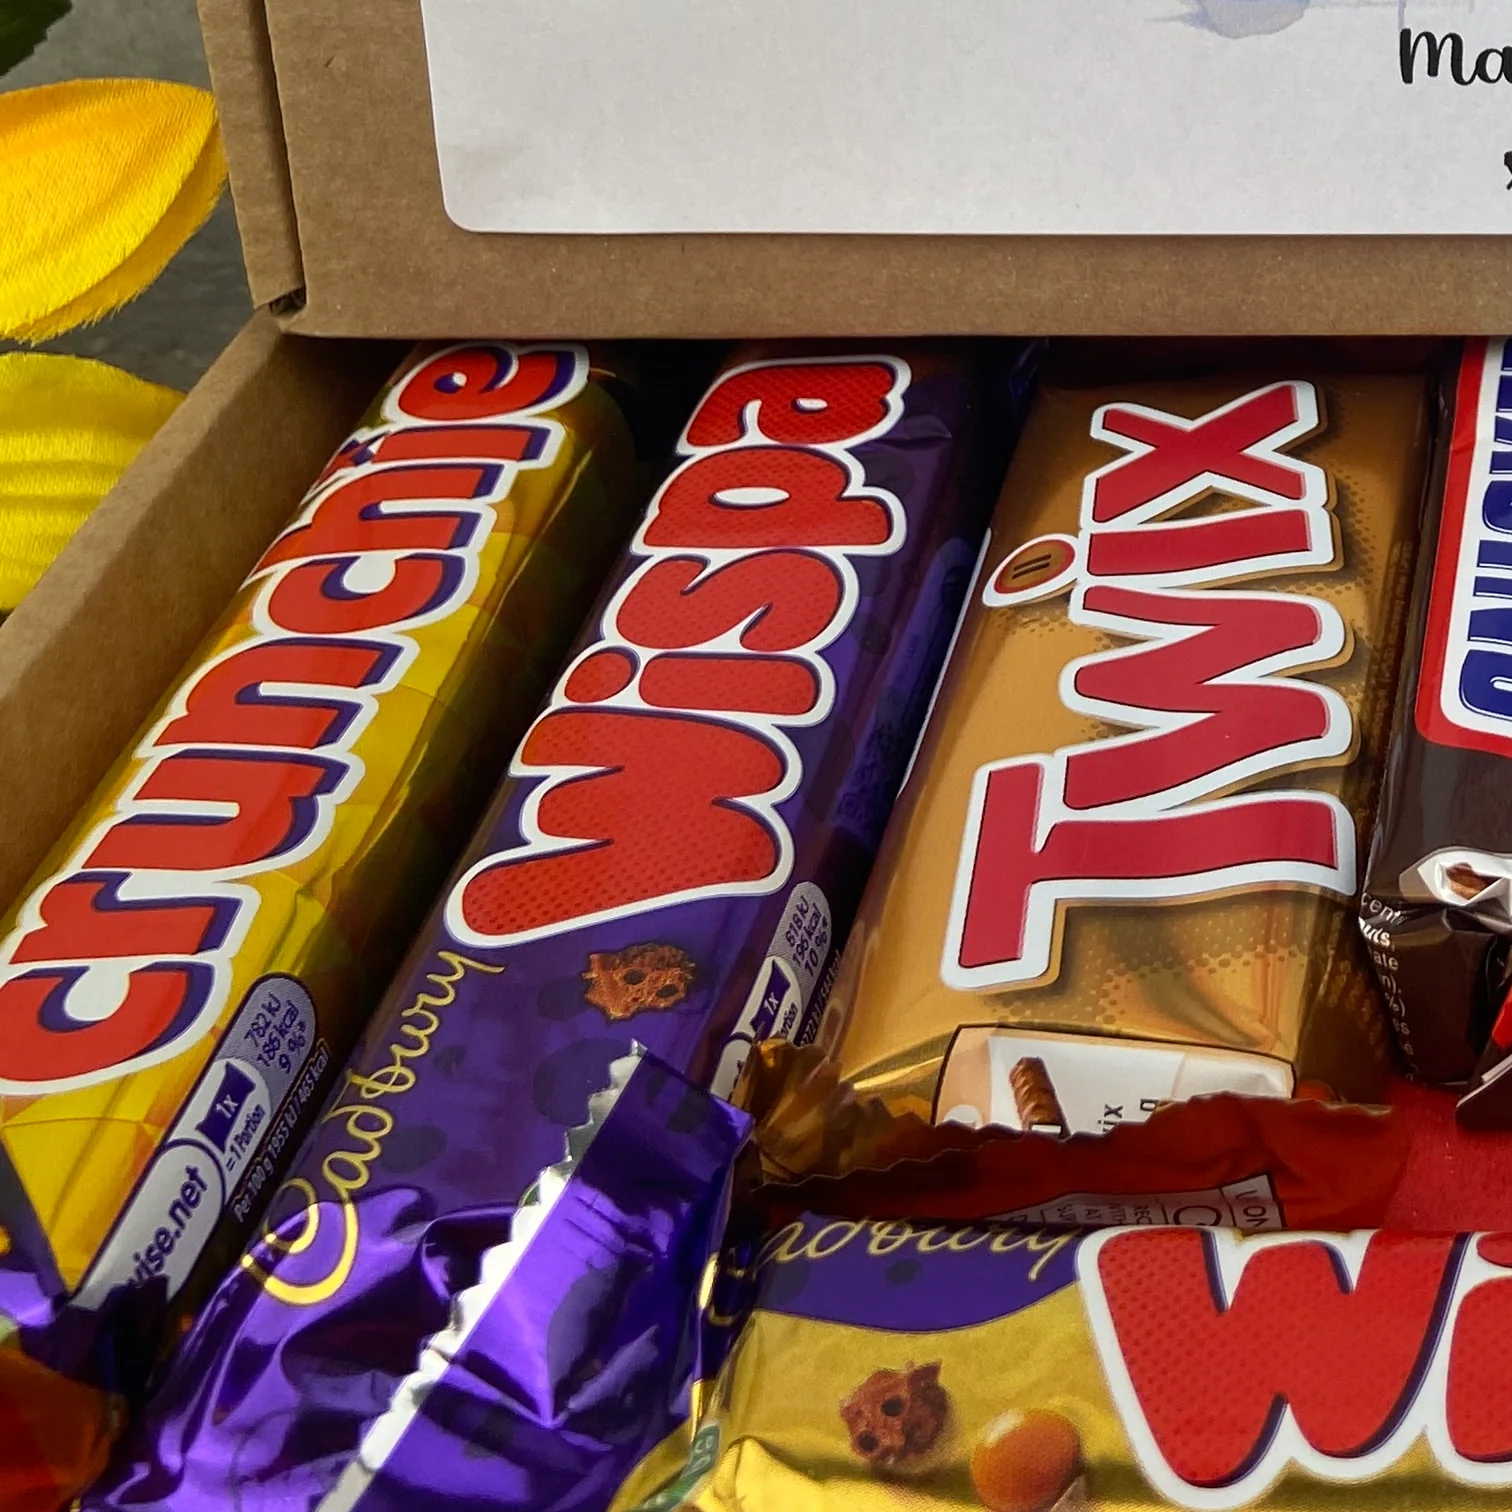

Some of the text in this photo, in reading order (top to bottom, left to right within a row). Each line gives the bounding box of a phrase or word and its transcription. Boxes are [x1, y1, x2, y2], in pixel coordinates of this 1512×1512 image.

[763, 991, 780, 1016] 1x
[244, 1013, 270, 1047] 782
[275, 1000, 300, 1039] kcal
[279, 1054, 292, 1074] 9
[215, 1093, 239, 1119] 1x
[241, 950, 506, 1305] Cadbury
